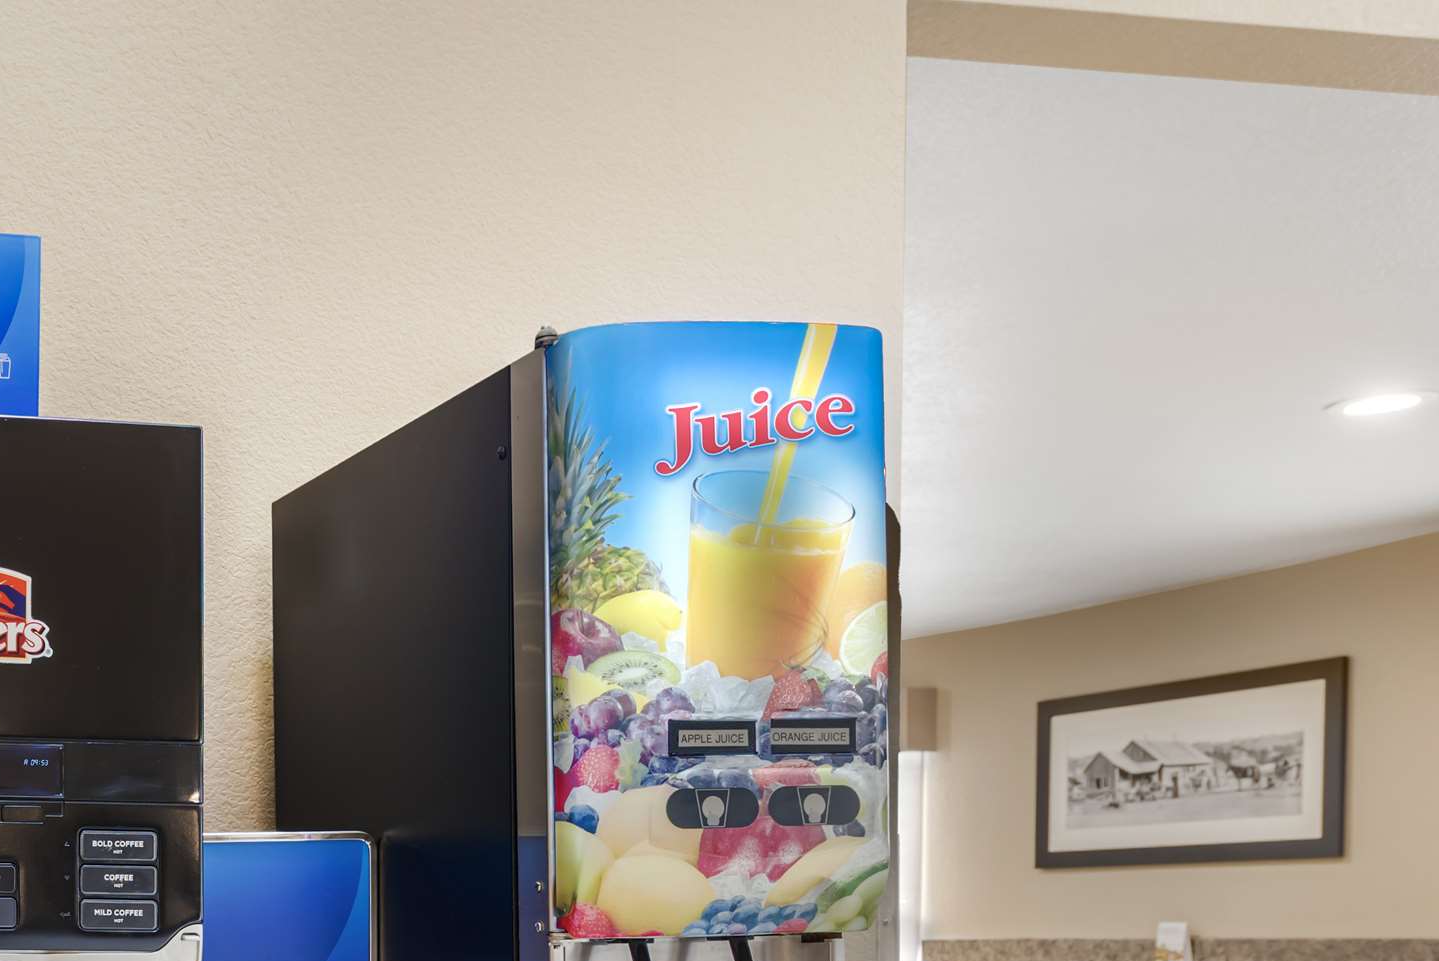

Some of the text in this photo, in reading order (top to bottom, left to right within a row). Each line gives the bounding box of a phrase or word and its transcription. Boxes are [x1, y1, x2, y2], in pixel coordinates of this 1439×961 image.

[655, 388, 855, 475] Juice
[680, 733, 745, 744] APPLE JUICE
[771, 731, 847, 743] ORANGE JUICE
[91, 840, 144, 848] BOLD COFFEE
[103, 873, 134, 882] COFFEE
[93, 908, 144, 917] MILD COFFEE
